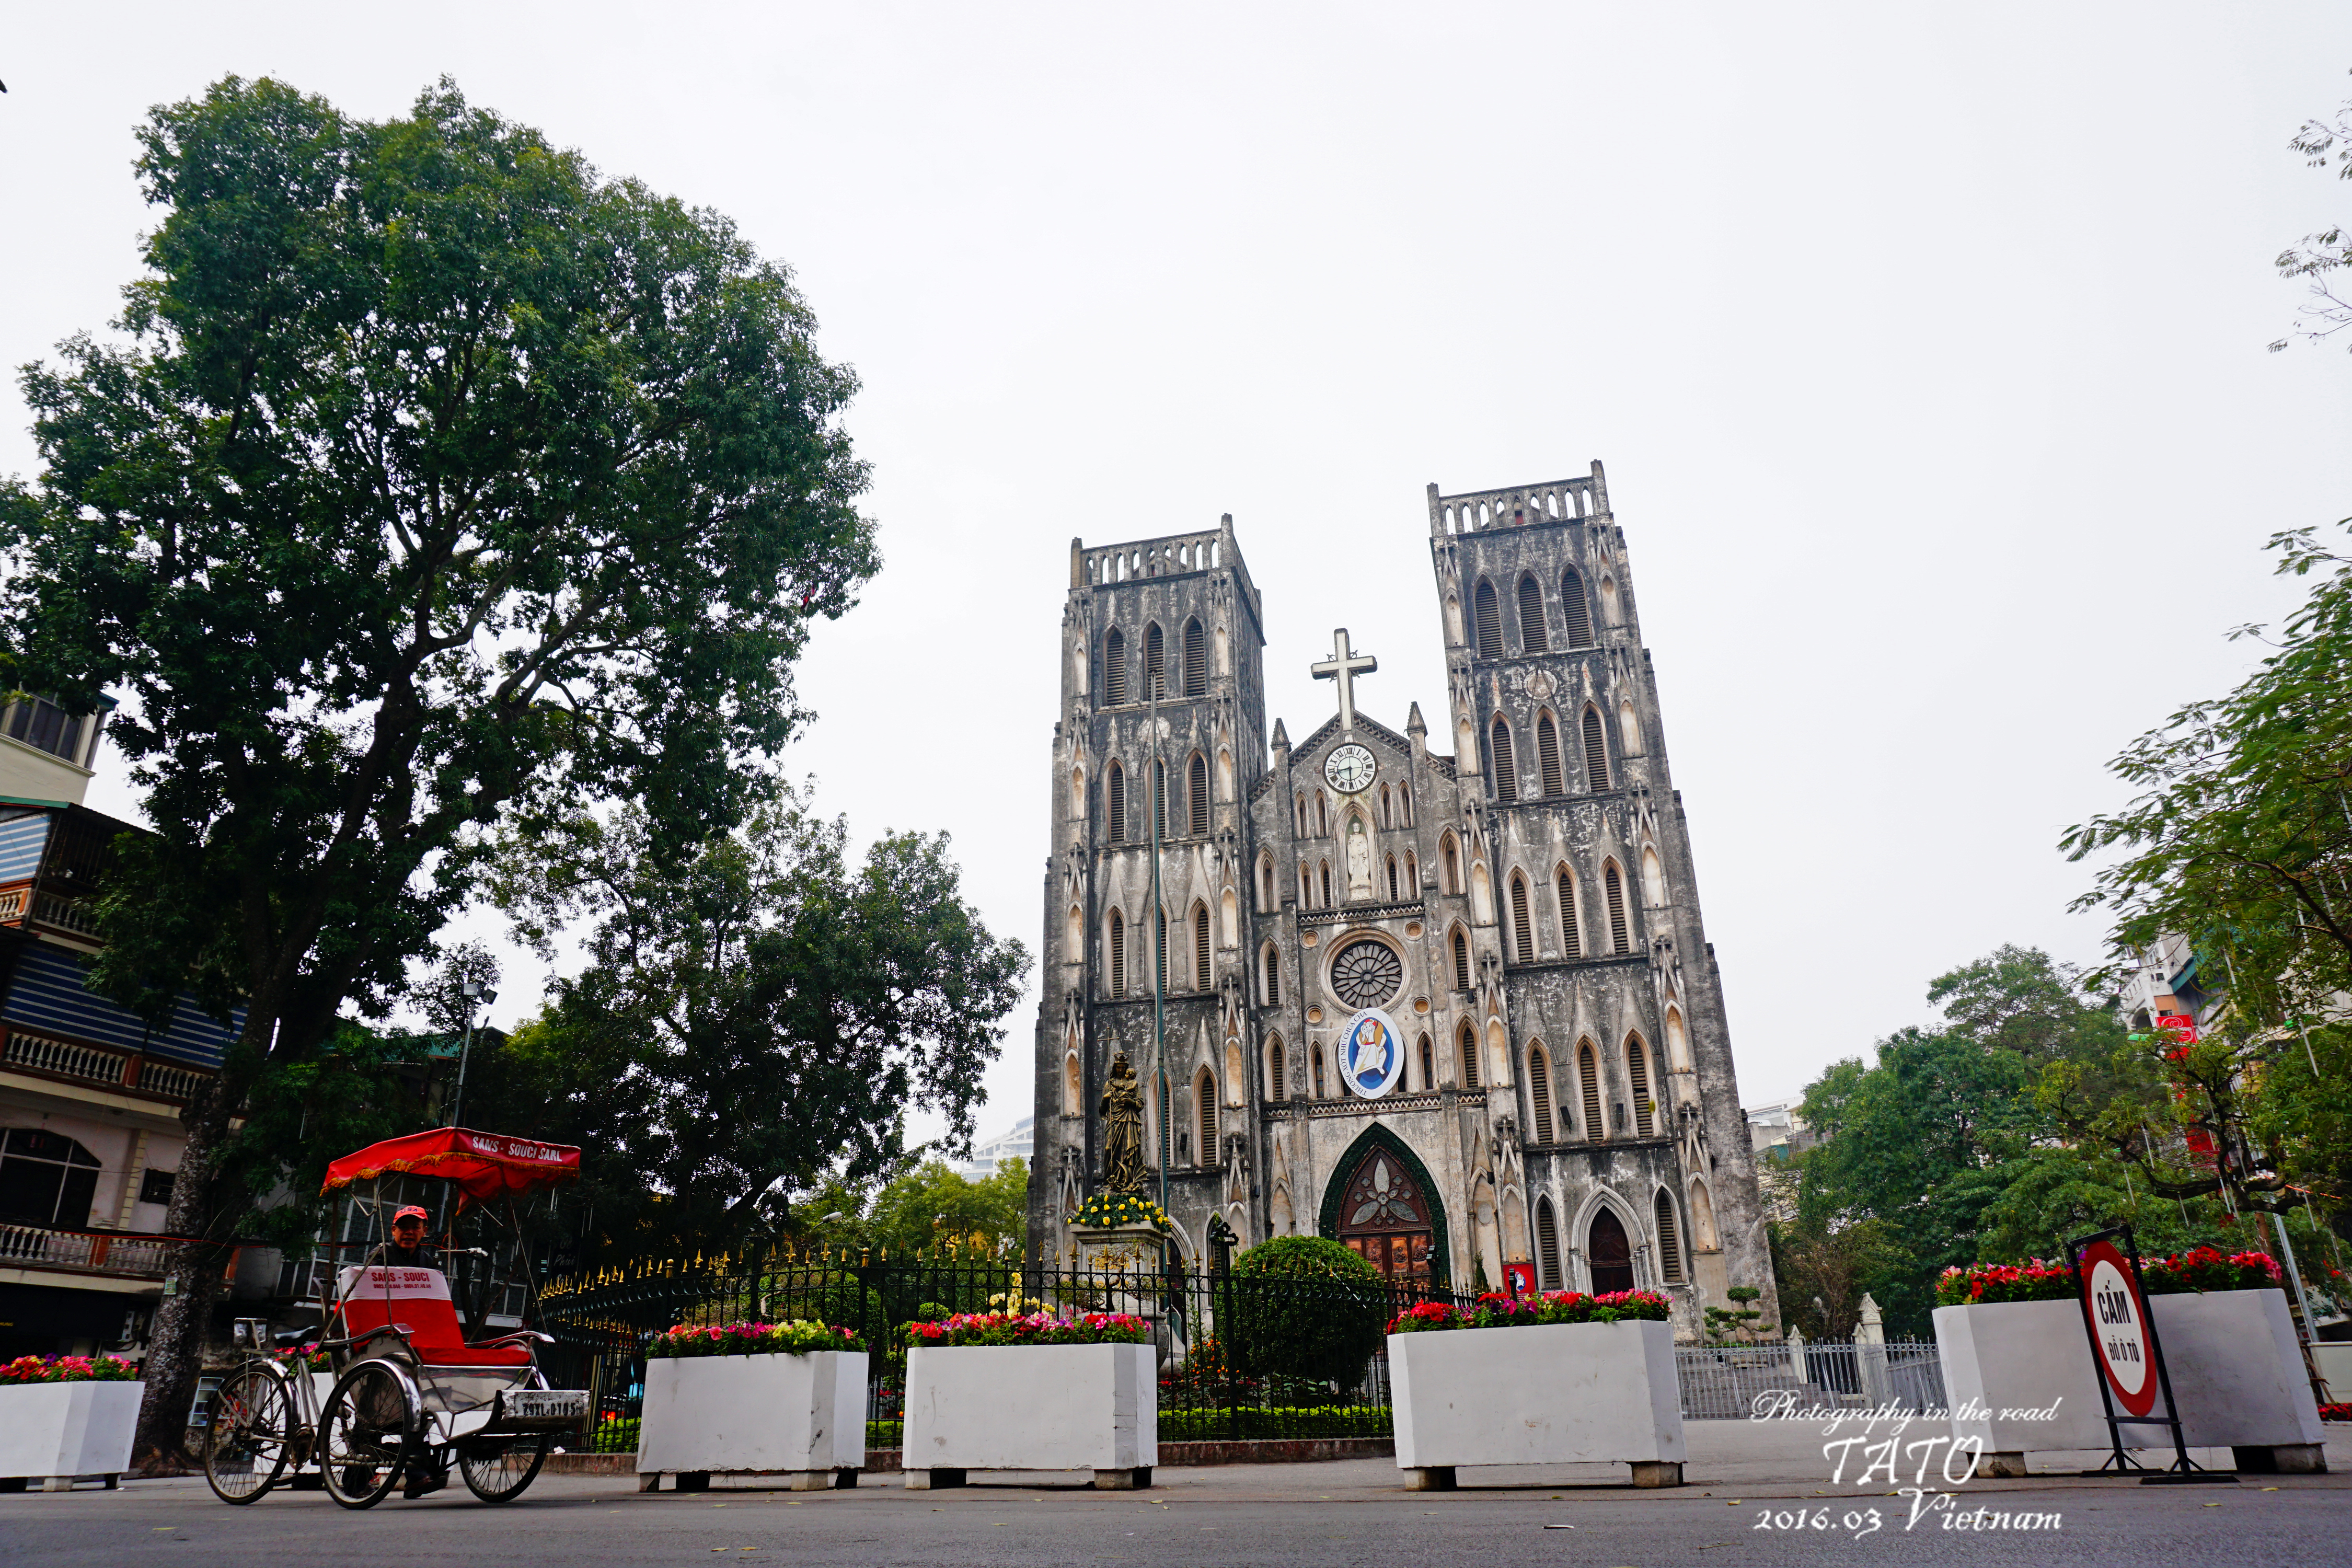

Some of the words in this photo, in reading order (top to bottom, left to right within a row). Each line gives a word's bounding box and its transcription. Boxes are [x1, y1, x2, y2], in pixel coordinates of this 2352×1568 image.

[1343, 1022, 1355, 1040] CHÚA
[1354, 1011, 1367, 1022] CHA
[472, 1136, 499, 1152] SANS
[508, 1143, 537, 1159] SOUCI
[538, 1148, 562, 1162] SARL
[403, 1272, 430, 1282] SOUCI
[2097, 1279, 2131, 1324] CẤM
[2108, 1334, 2120, 1361] ĐỖ
[2120, 1338, 2127, 1362] Ô
[2127, 1338, 2140, 1363] TÔ
